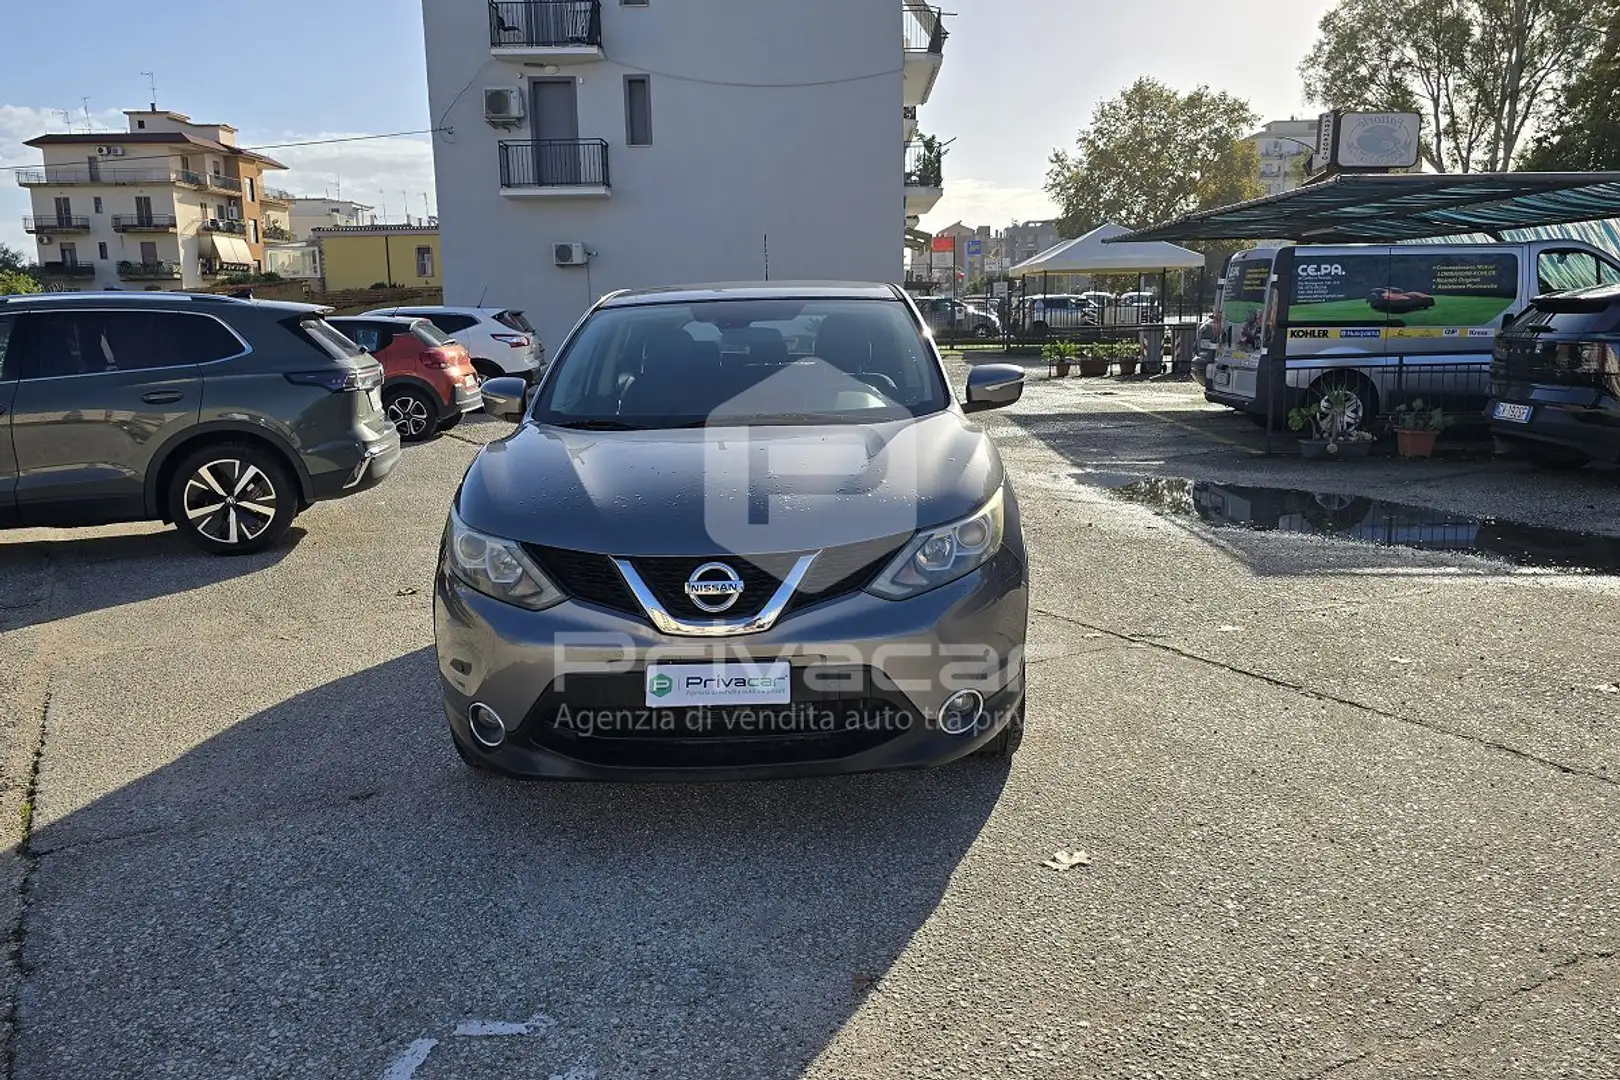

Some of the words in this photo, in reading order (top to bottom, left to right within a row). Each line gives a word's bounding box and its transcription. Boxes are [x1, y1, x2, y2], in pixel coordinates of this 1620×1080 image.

[1297, 264, 1346, 276] CE.PA.
[1290, 329, 1329, 338] KOHLER
[1347, 330, 1380, 338] Husqvarna
[691, 583, 738, 593] NISSAN
[685, 674, 786, 689] Privacar
